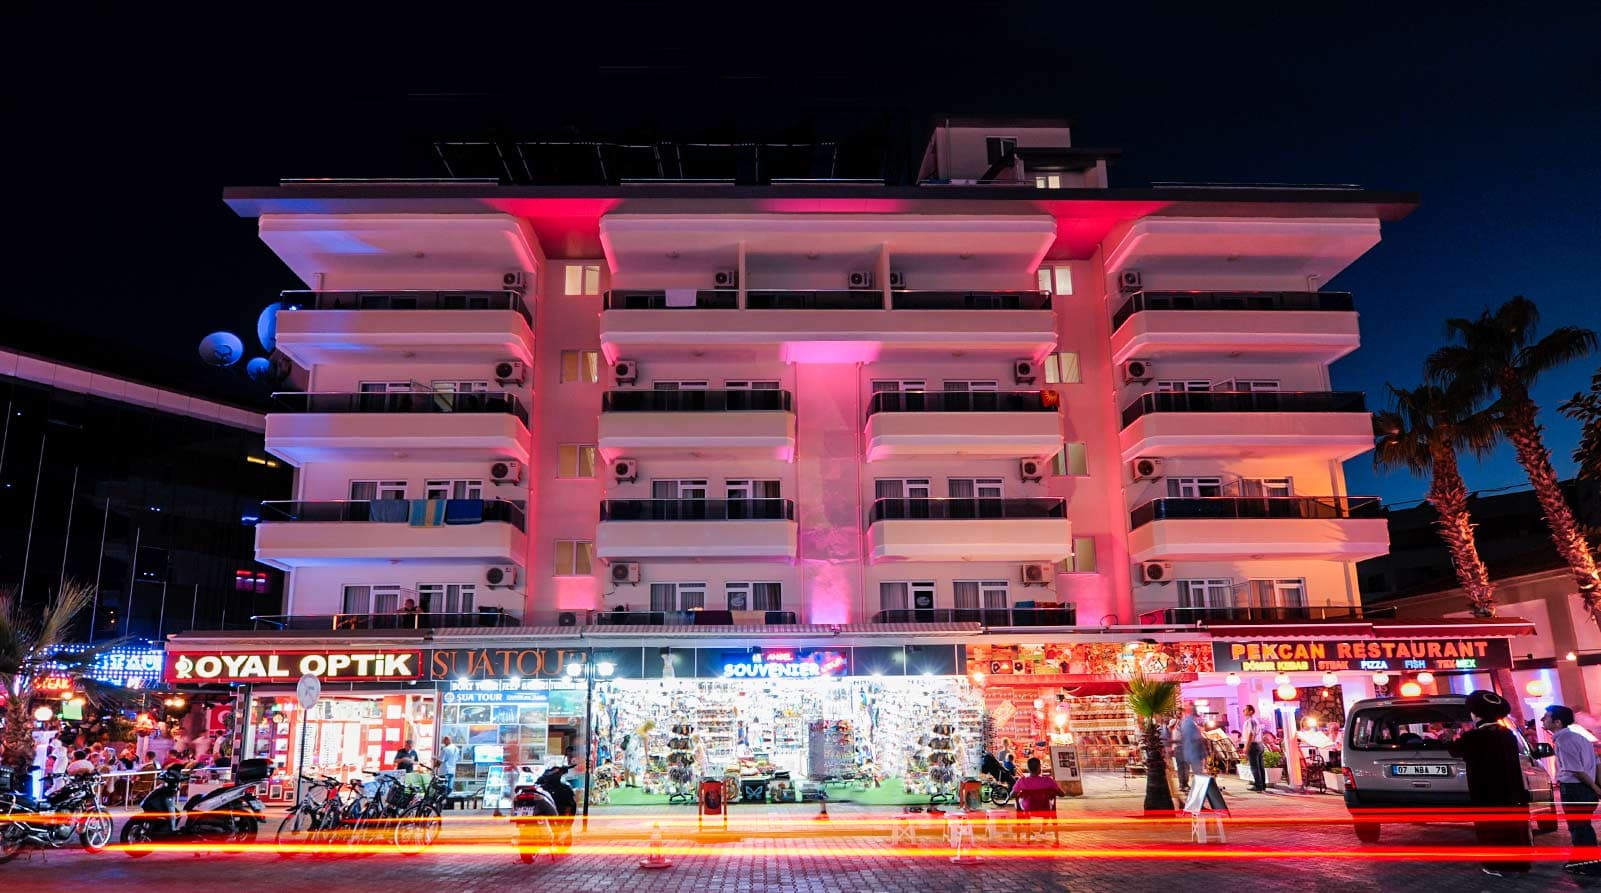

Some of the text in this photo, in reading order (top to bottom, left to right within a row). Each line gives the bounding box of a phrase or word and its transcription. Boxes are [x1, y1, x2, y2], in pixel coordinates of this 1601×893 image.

[1231, 641, 1488, 660] PEKCAN RESTAURANT
[175, 655, 290, 678] ROYAL
[1318, 660, 1350, 670] STEAK
[1360, 660, 1388, 669] PIZZA
[1405, 660, 1427, 669] FISH
[1398, 766, 1408, 774] 07
